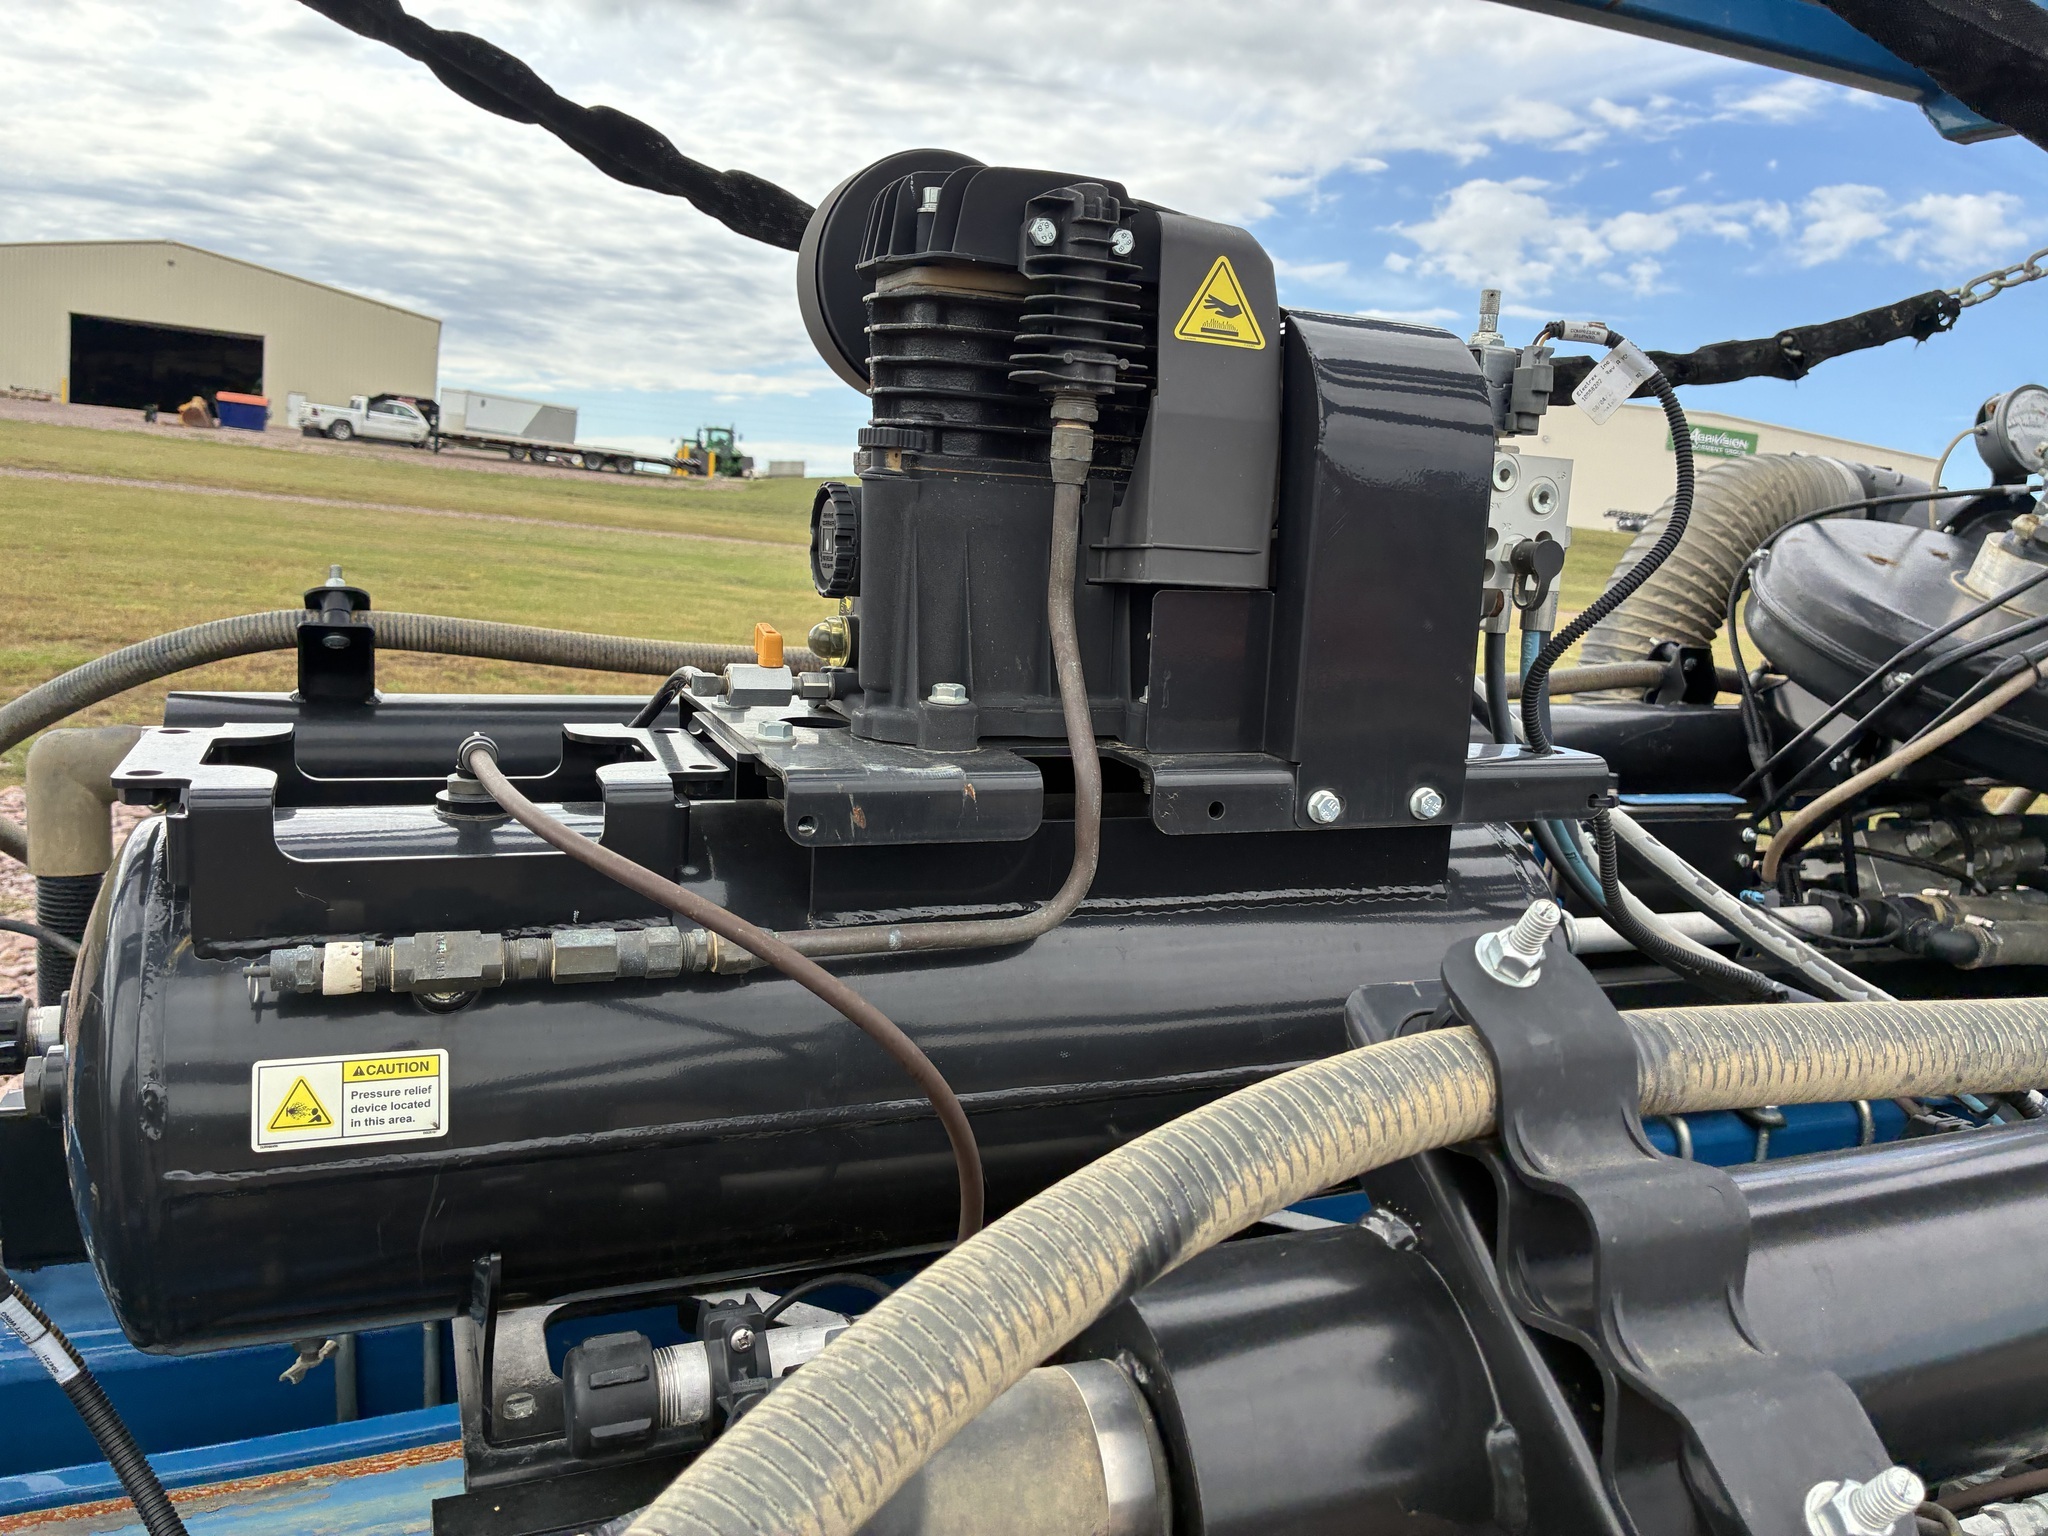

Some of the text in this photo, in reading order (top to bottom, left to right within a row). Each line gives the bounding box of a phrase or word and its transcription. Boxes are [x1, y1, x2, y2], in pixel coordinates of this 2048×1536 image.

[366, 1061, 430, 1076] CAUTION
[351, 1085, 432, 1100] Pressure relief
[351, 1099, 431, 1114] device located
[351, 1115, 416, 1128] in this area.
[0, 1311, 31, 1341] LEFT WING
